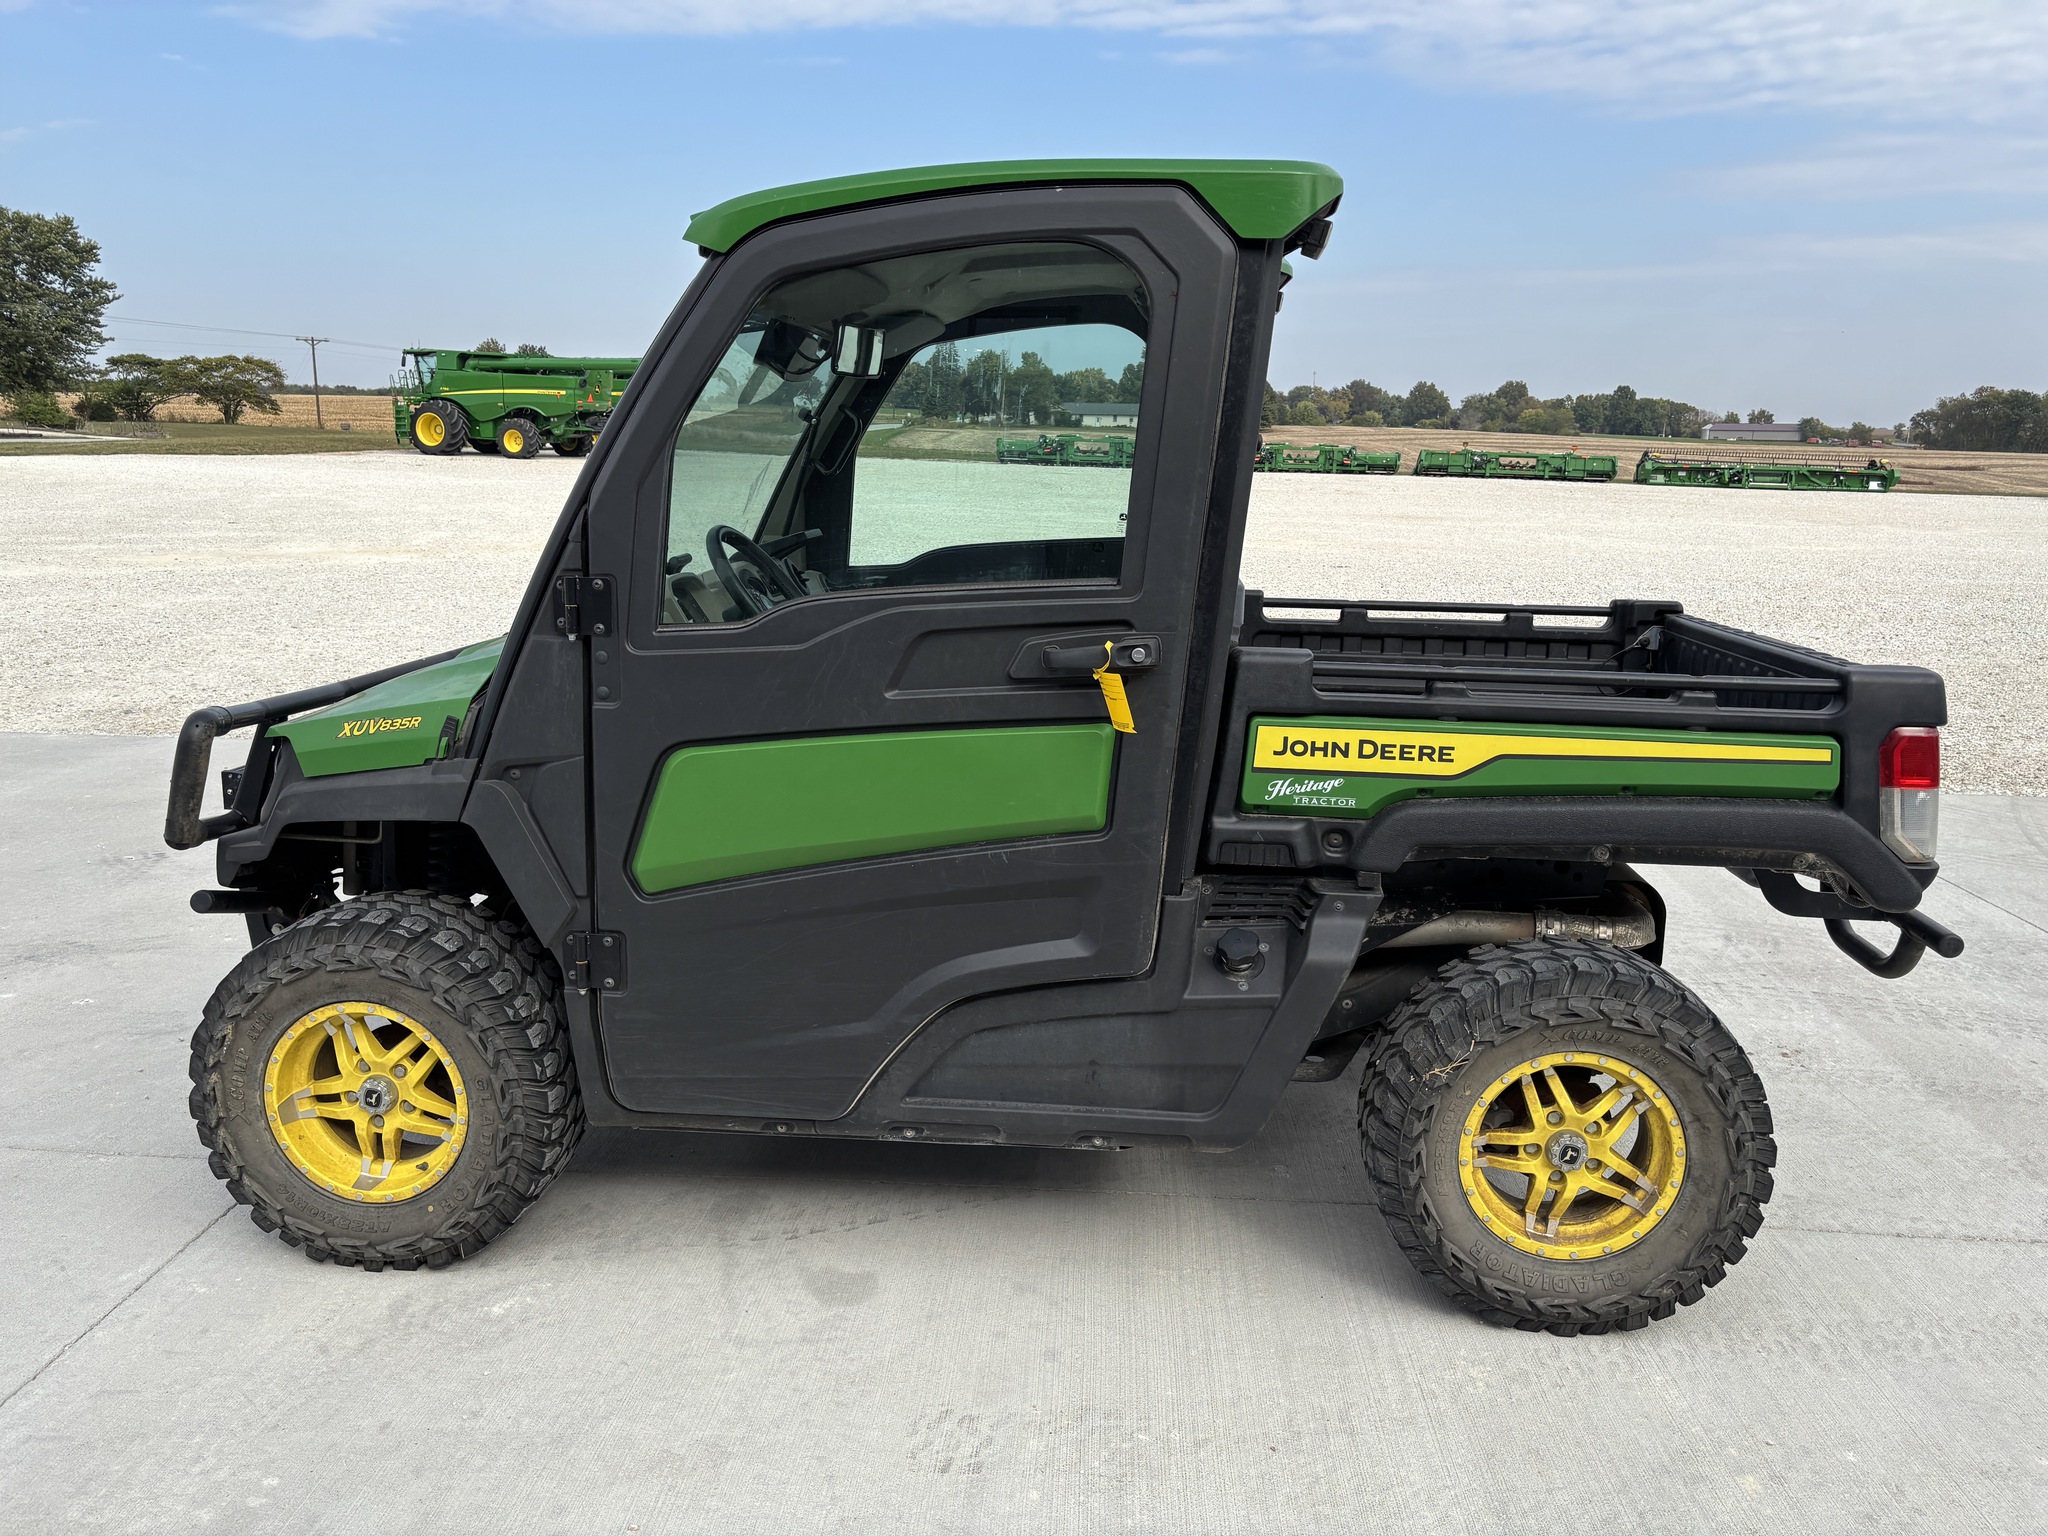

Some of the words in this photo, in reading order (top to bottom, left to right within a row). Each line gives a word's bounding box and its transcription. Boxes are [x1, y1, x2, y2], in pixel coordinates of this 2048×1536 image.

[335, 716, 423, 739] XUV835R
[1272, 736, 1350, 759] JOHN
[1357, 739, 1456, 763] DEERE
[1264, 777, 1345, 801] Heritage
[1294, 796, 1356, 807] TRACTOR
[439, 1075, 495, 1215] GLADIATOR
[1469, 1239, 1632, 1294] GLADIATOR
